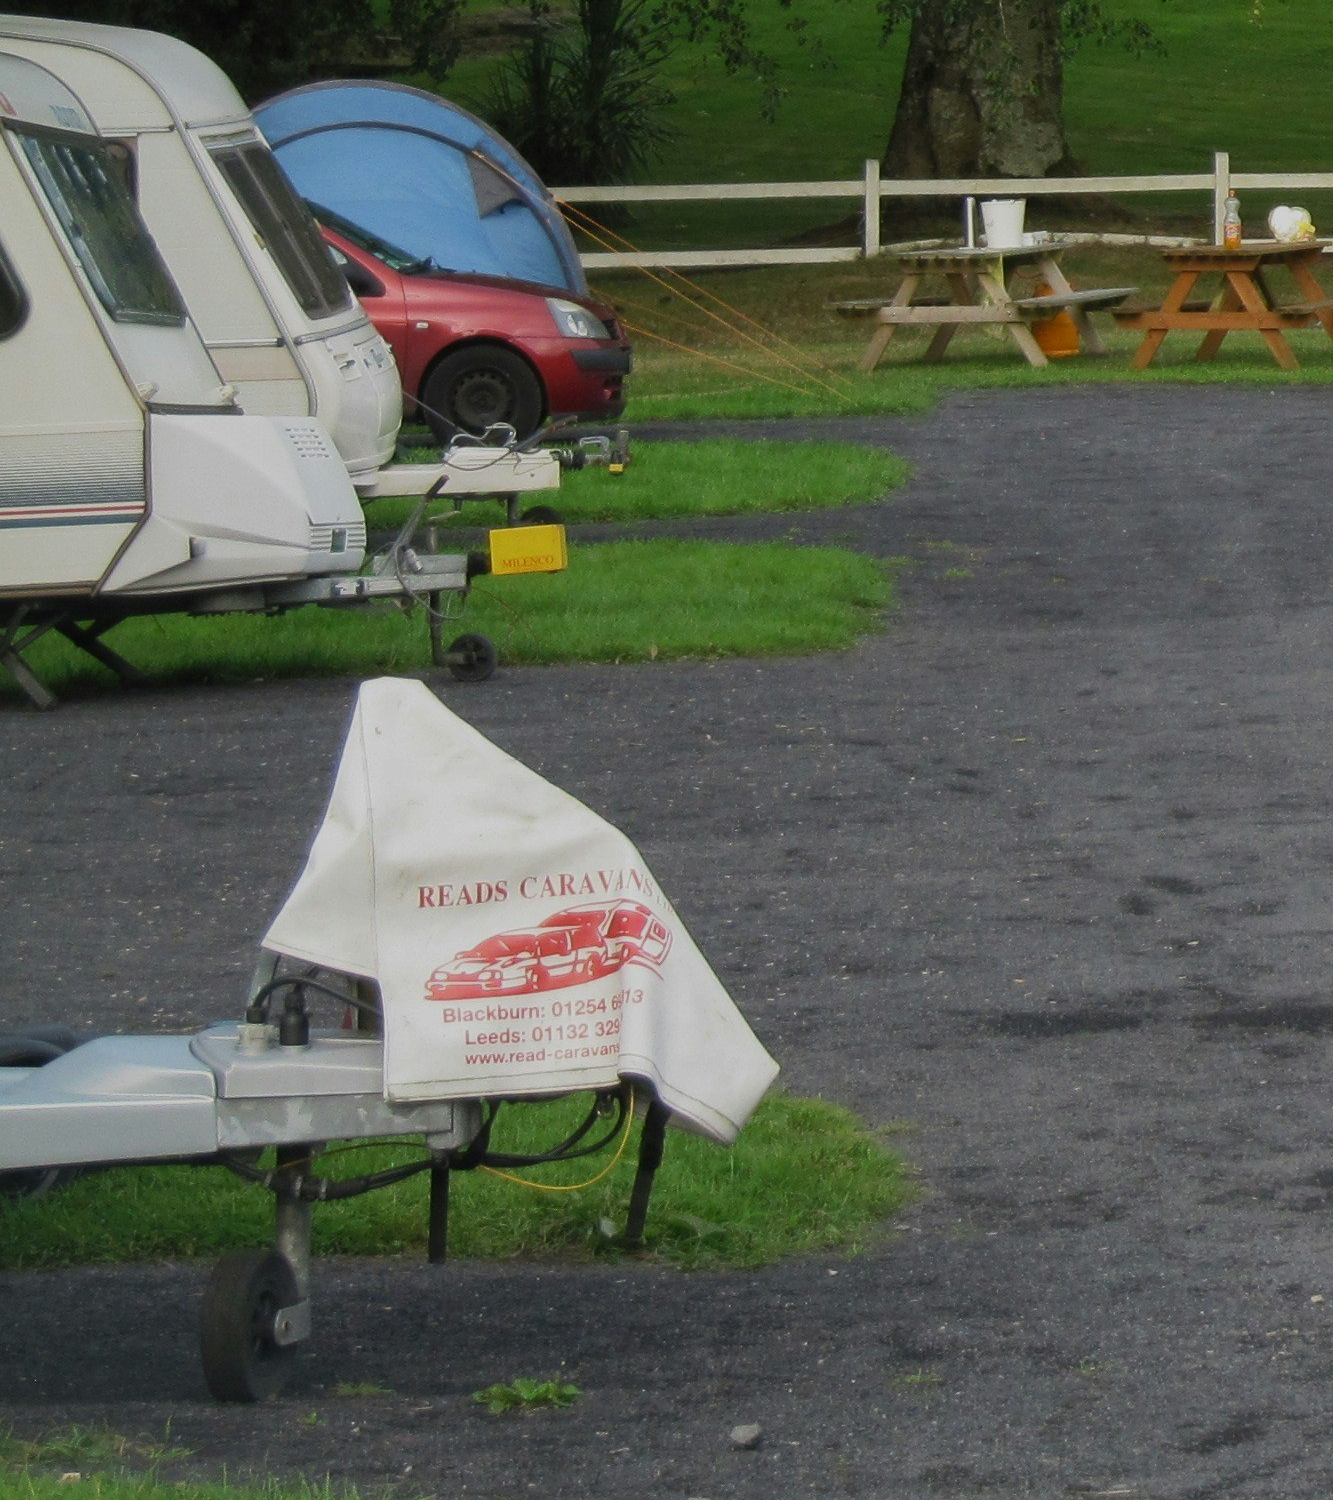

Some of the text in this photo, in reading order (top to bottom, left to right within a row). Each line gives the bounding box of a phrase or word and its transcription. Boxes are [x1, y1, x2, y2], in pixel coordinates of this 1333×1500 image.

[502, 555, 554, 568] MILENCO
[418, 881, 508, 908] READS
[519, 868, 653, 900] CARAVANS
[443, 1004, 546, 1024] Blackburn:
[551, 998, 607, 1016] 01254
[465, 1016, 622, 1045] Leeds: 01132 329
